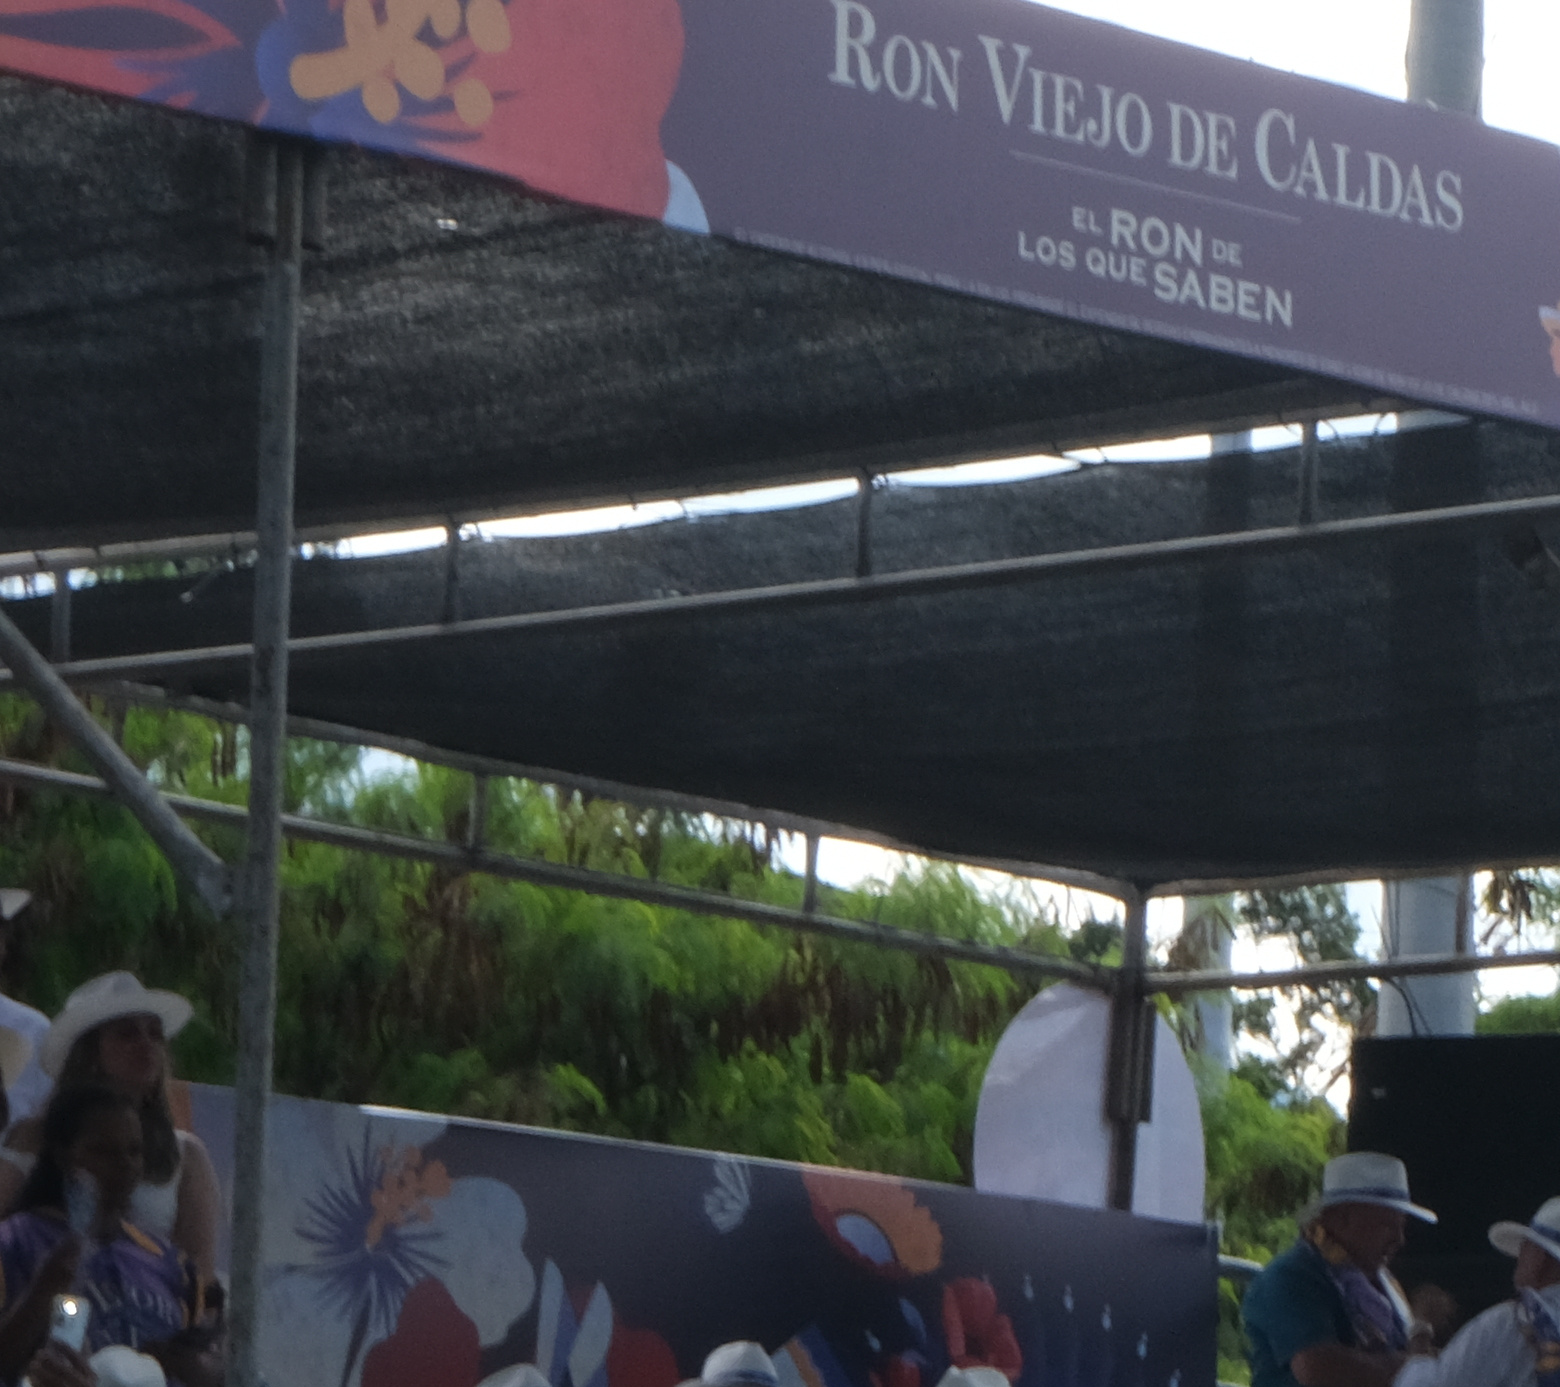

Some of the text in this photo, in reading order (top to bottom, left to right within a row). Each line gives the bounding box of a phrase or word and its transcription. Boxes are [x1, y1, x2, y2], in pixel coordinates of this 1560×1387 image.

[828, 0, 1466, 234] RON VIEJO DE CALDAS
[1017, 230, 1078, 272] LOS
[1085, 246, 1147, 288] QUE
[1153, 262, 1295, 329] SABEN
[1071, 206, 1244, 268] EL RON DE
